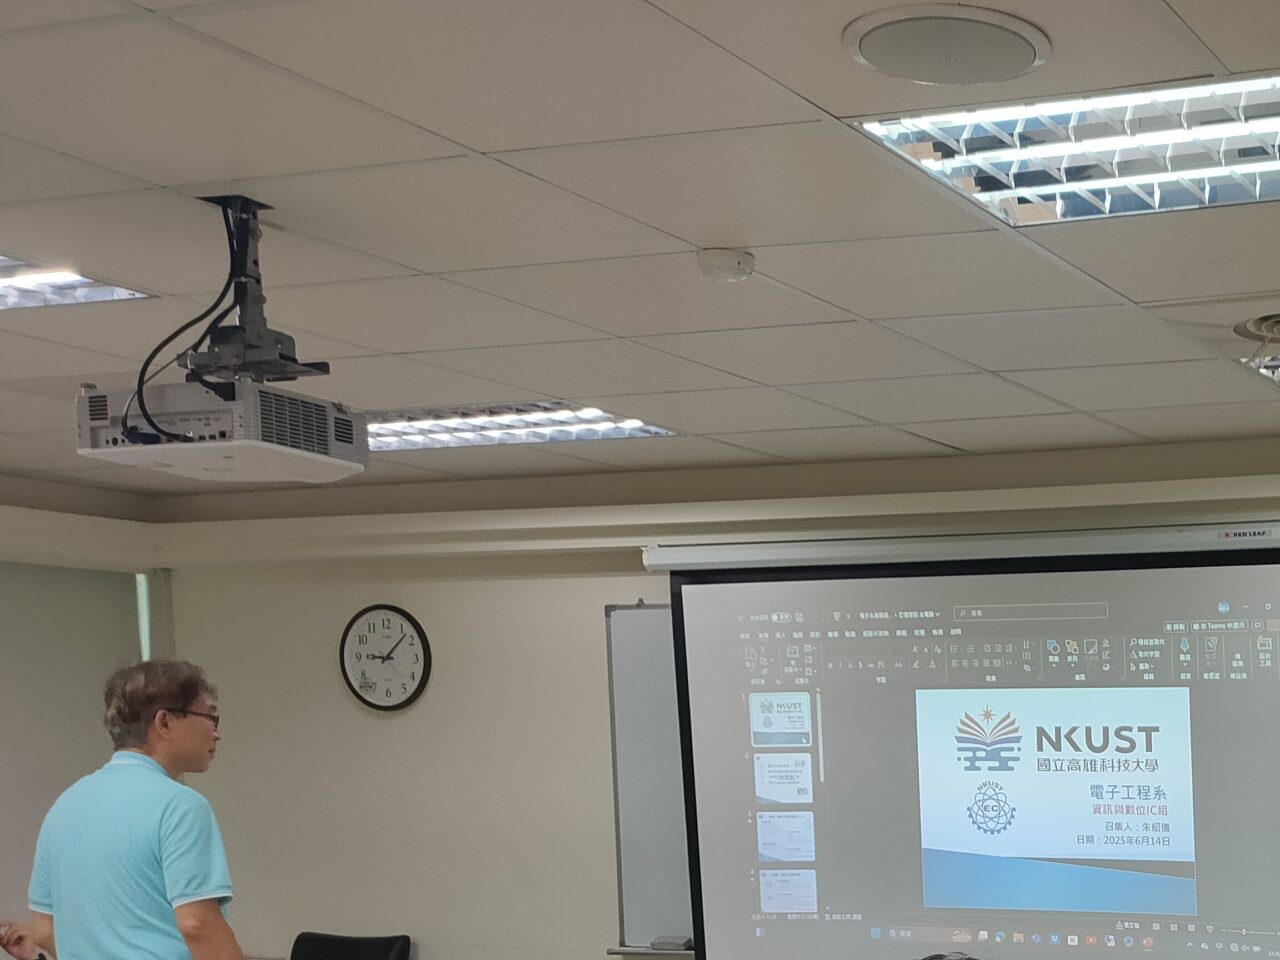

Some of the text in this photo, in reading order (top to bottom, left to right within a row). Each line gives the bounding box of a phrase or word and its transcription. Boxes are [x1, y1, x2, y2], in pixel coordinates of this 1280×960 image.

[368, 622, 376, 633] 11
[382, 618, 391, 629] 12
[400, 623, 404, 634] 1
[358, 634, 368, 645] 10
[409, 635, 415, 646] 2
[355, 652, 362, 663] 9
[414, 653, 419, 664] 3
[410, 671, 415, 682] 4
[385, 688, 392, 698] 6
[401, 683, 407, 694] 5
[776, 702, 802, 710] NKUST
[1036, 725, 1160, 754] NKUST
[1037, 757, 1159, 773] 國立高雄科技大學
[977, 780, 1005, 791] NKUST
[1090, 784, 1167, 801] 電子工程系
[983, 804, 999, 812] EC
[1092, 803, 1168, 816] 資訊與數位IC組
